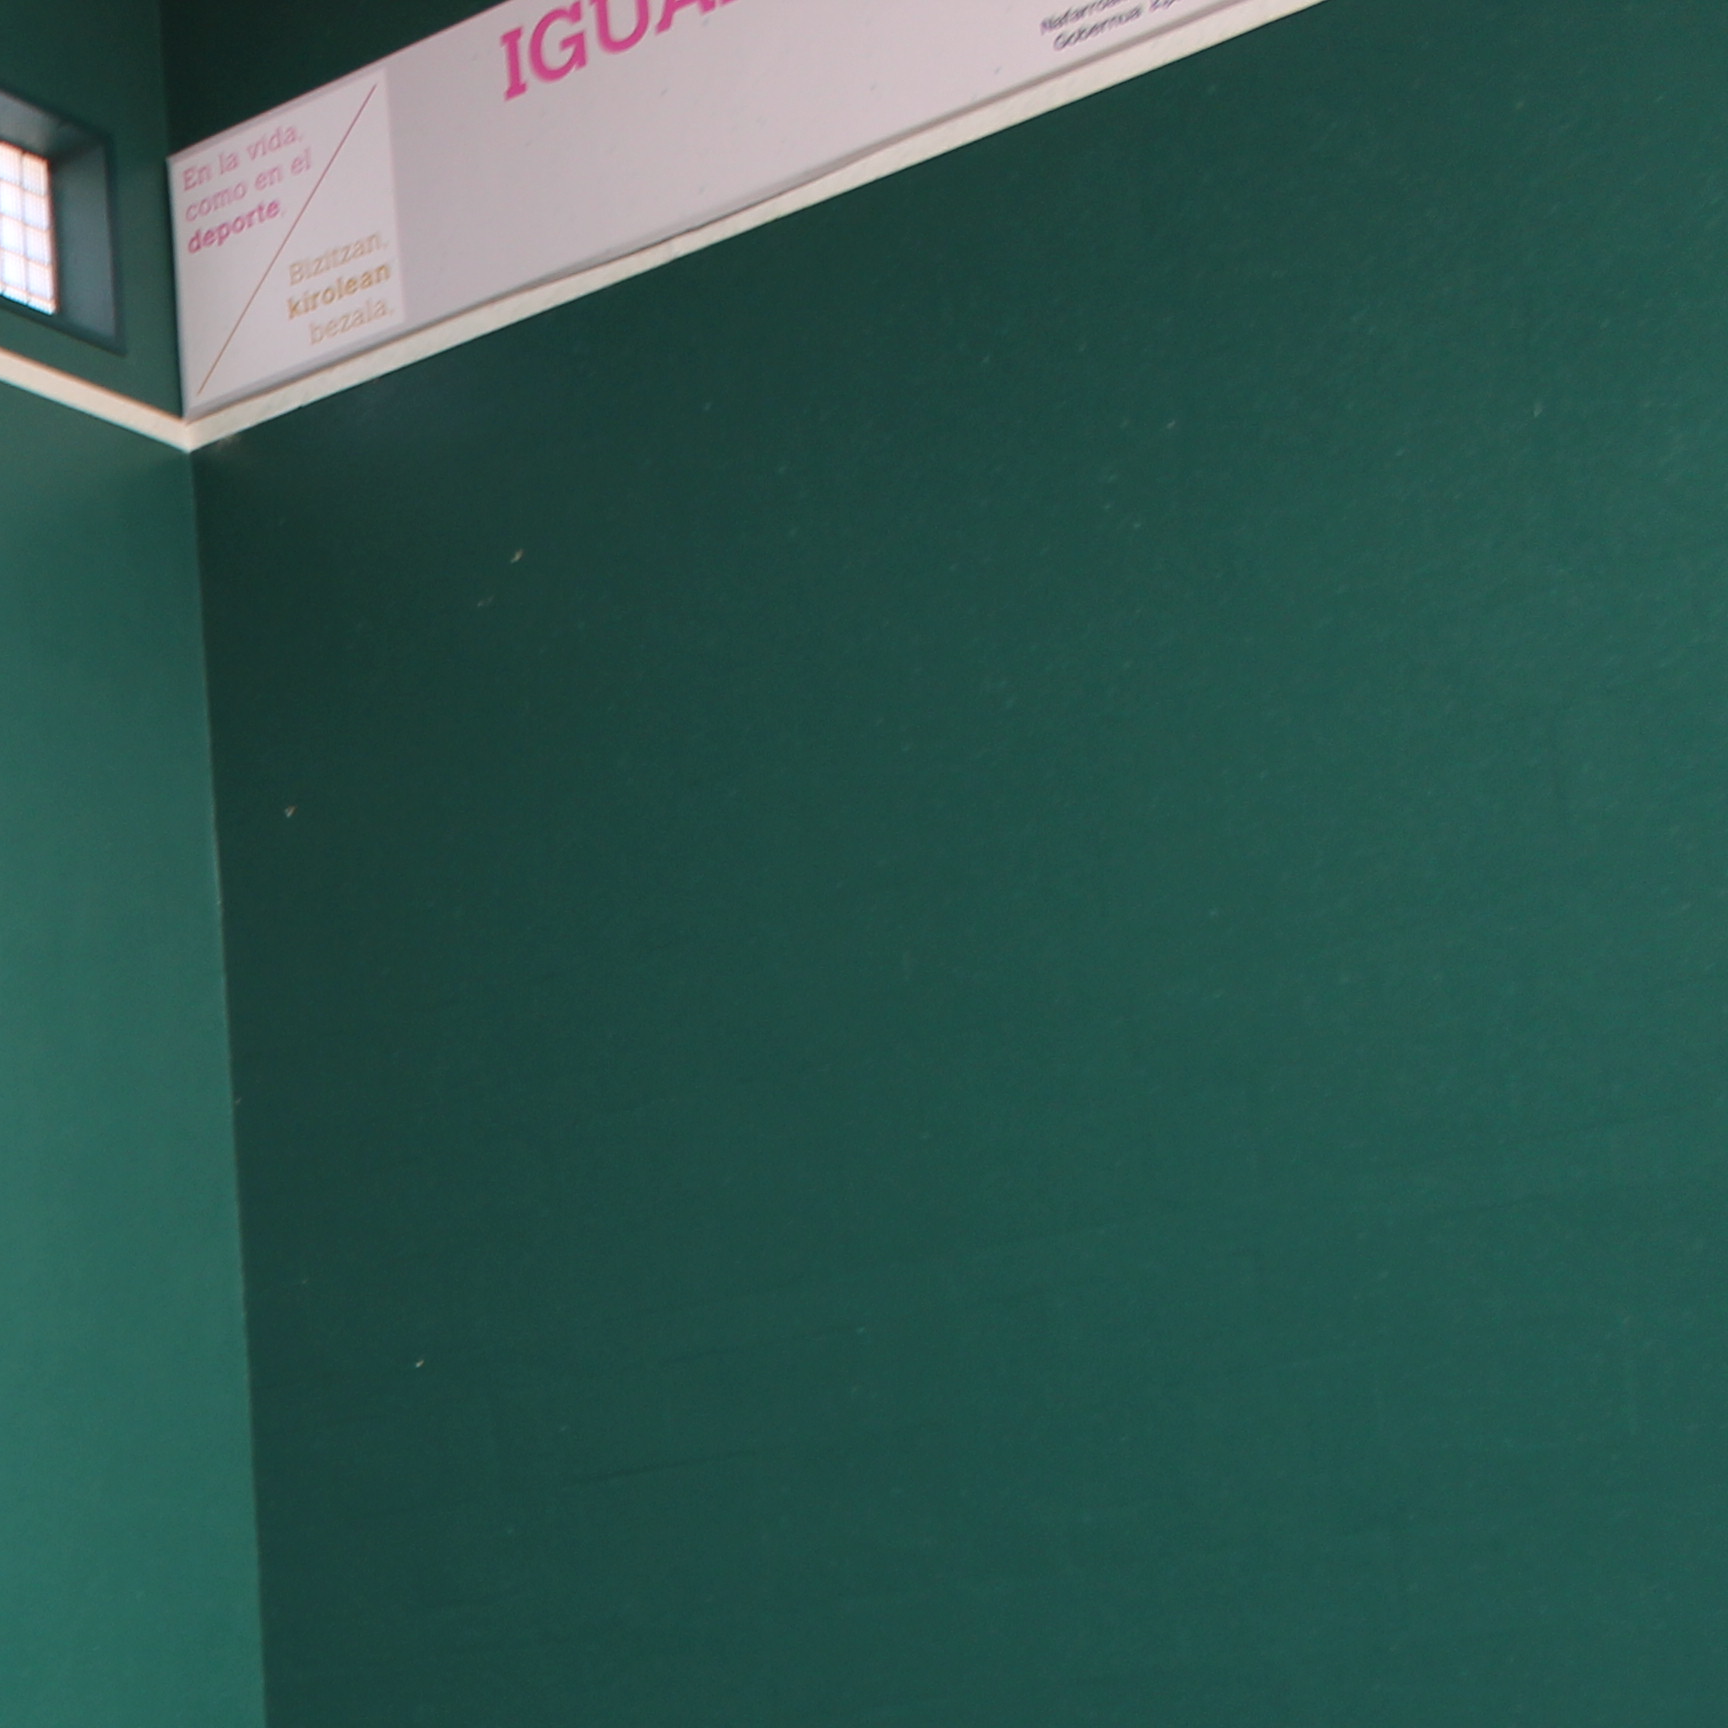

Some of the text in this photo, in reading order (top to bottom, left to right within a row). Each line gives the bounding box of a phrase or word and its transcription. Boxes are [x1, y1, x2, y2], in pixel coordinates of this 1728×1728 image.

[182, 163, 213, 192] En
[218, 151, 240, 175] la
[185, 147, 312, 222] como en el
[287, 263, 392, 321] kirolean
